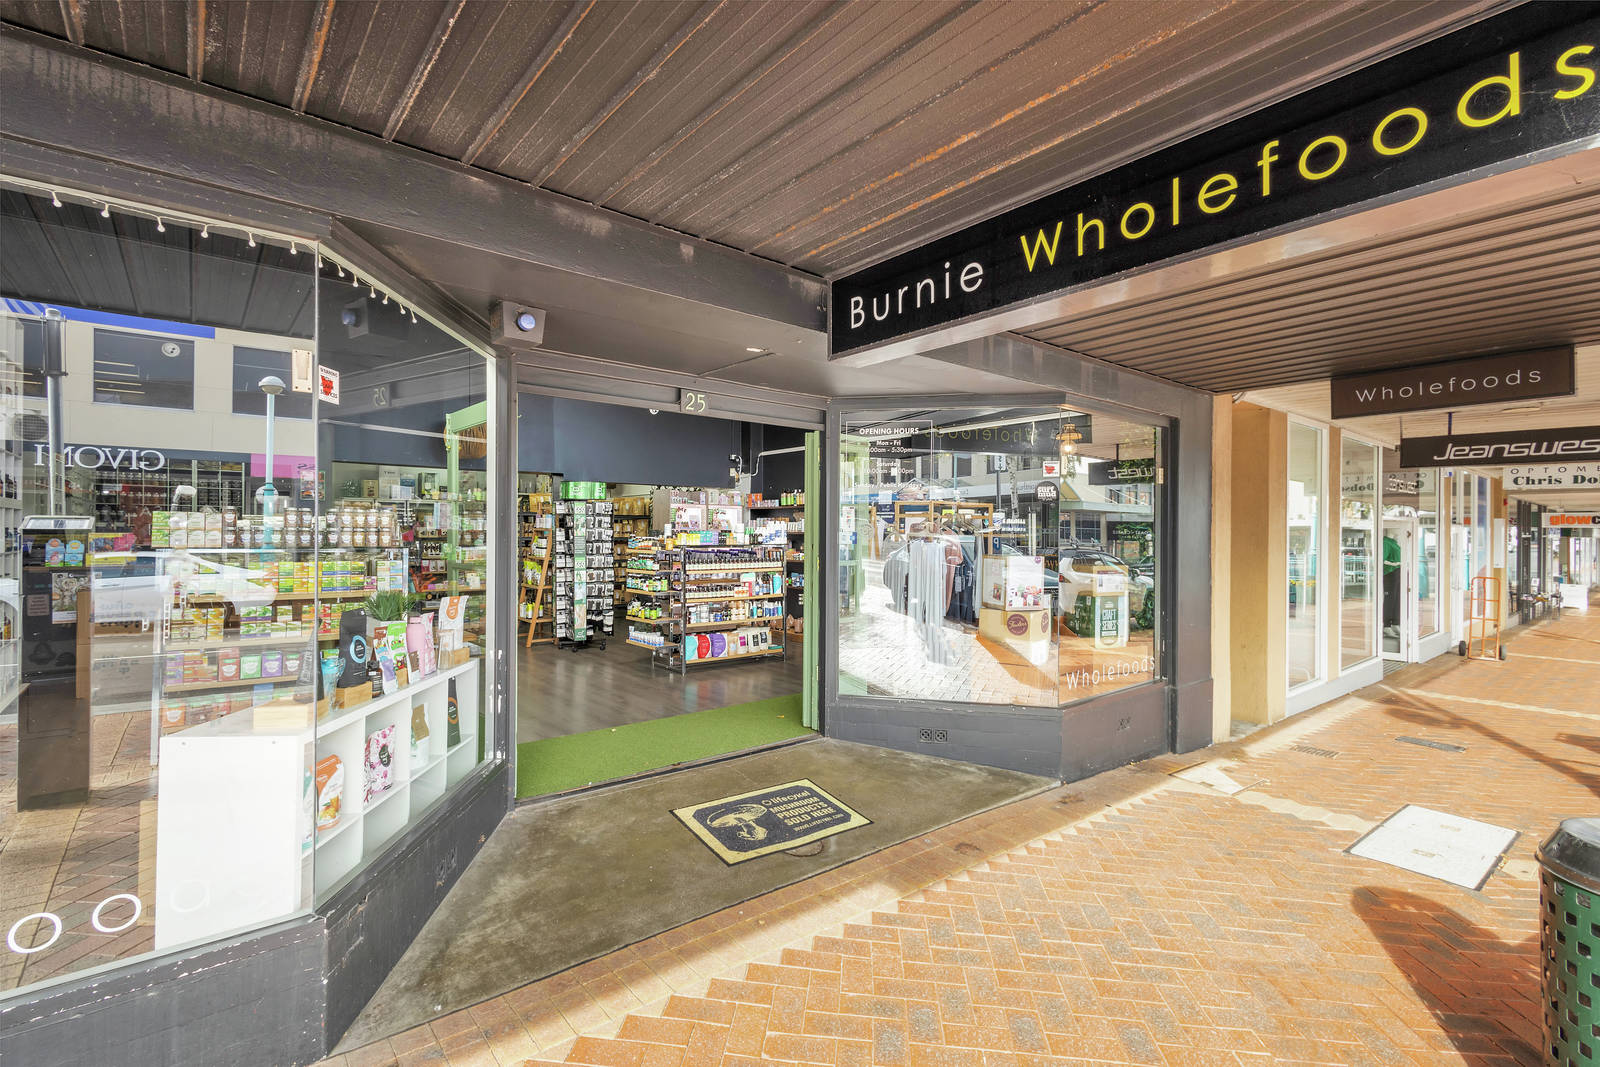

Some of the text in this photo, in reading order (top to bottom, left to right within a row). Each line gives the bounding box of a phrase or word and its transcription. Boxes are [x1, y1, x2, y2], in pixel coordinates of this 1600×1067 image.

[850, 45, 1596, 329] Burnie Wholefoods
[1355, 368, 1542, 402] Wholefoods
[685, 392, 706, 413] 25
[859, 427, 919, 435] OPENING HOURS
[1433, 439, 1600, 461] Jeanswes
[1513, 474, 1600, 486] Chris Do
[1066, 655, 1155, 690] Wholefoods
[769, 796, 821, 814] MUSHROOM
[770, 790, 811, 804] lifecykel
[776, 801, 828, 820] PRODUCTS
[784, 806, 837, 826] SOLD HERE
